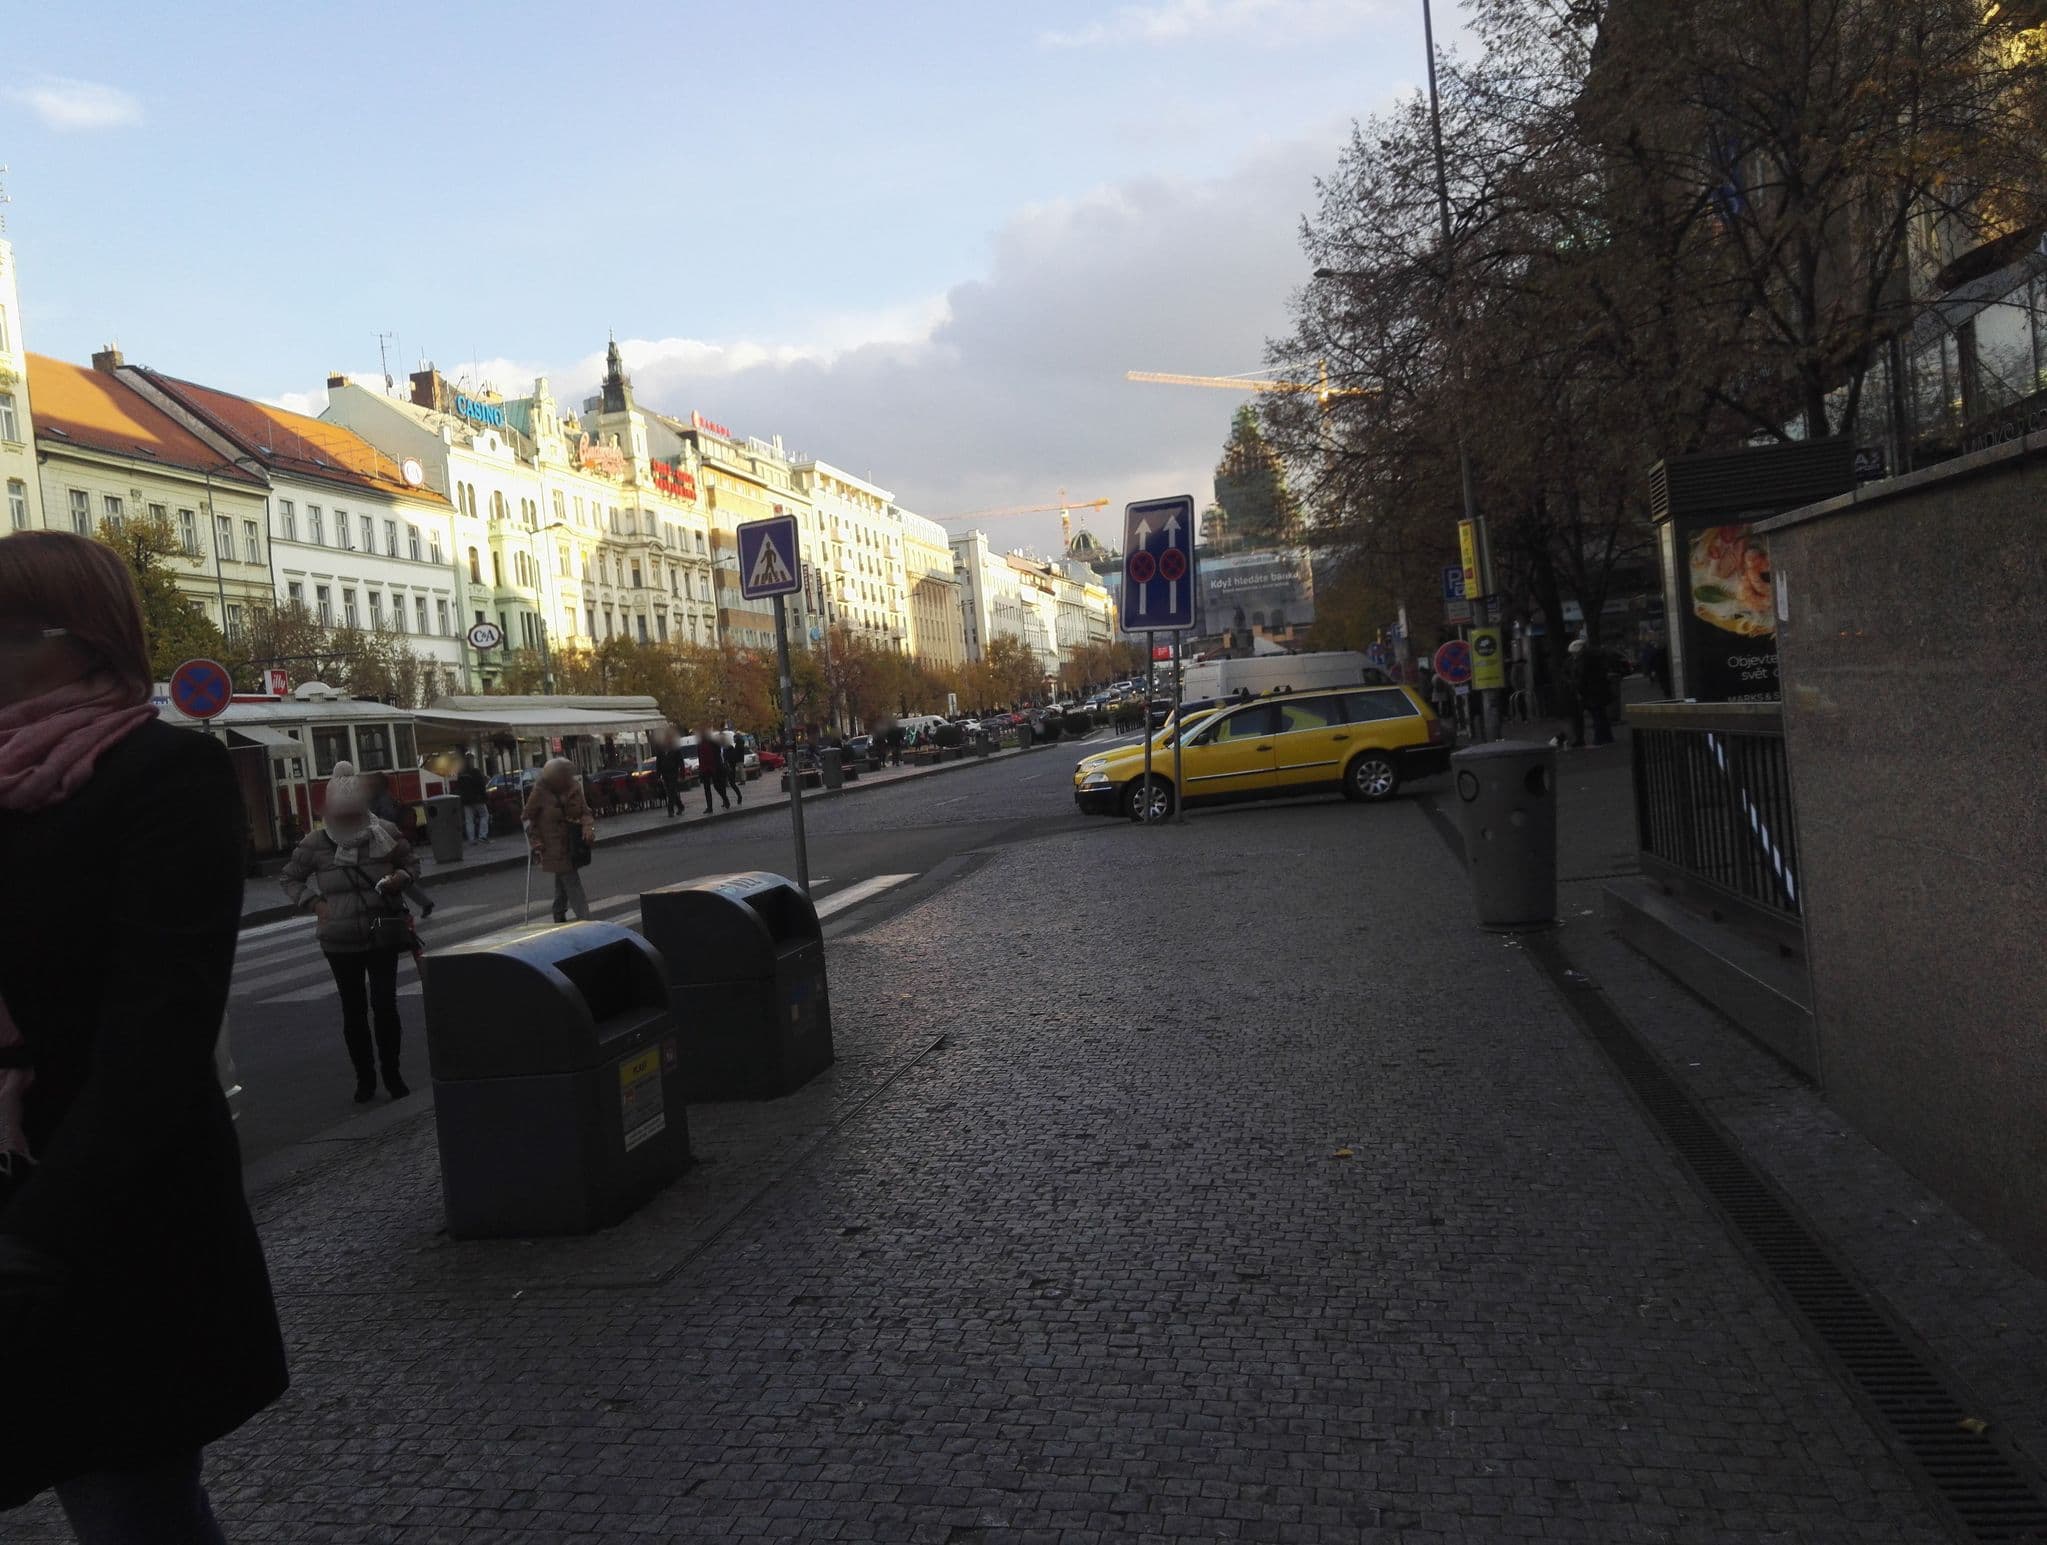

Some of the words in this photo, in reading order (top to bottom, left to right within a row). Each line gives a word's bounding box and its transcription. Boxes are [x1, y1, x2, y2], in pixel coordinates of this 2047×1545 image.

[456, 394, 504, 428] CASINO
[474, 629, 495, 643] C&A
[1727, 653, 1778, 669] Objevte
[273, 673, 286, 689] illy
[1741, 667, 1769, 681] svět
